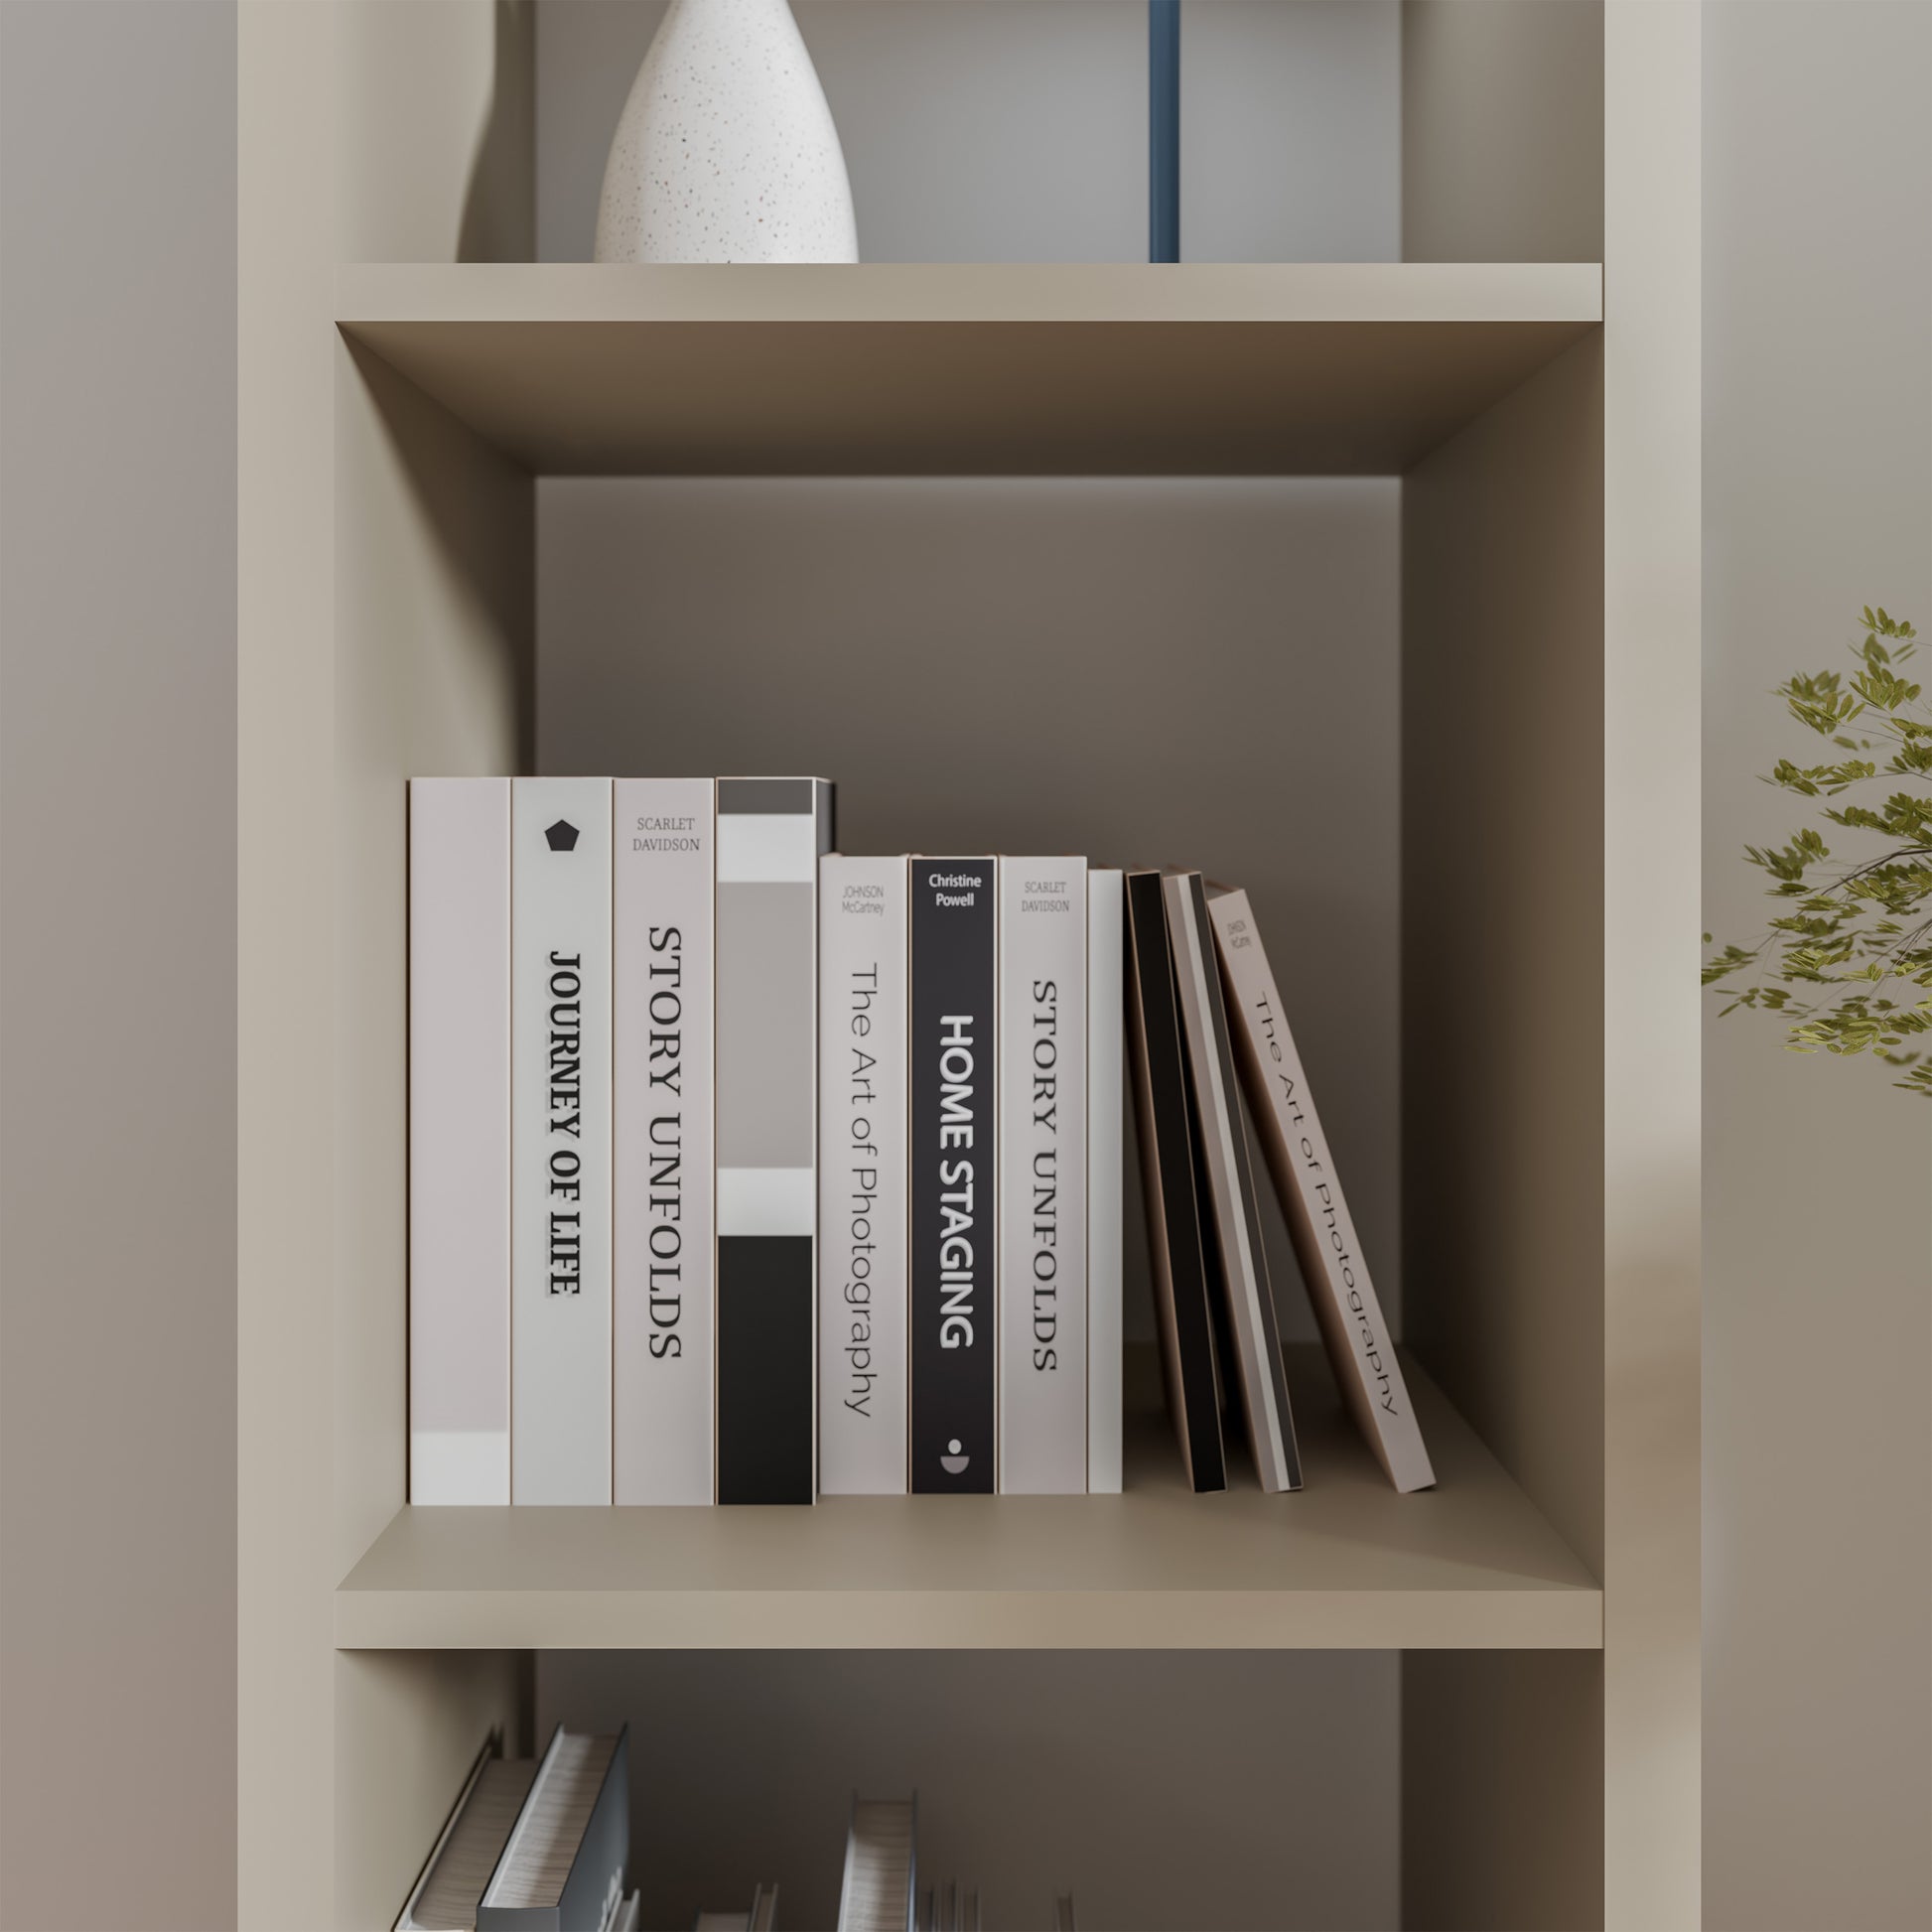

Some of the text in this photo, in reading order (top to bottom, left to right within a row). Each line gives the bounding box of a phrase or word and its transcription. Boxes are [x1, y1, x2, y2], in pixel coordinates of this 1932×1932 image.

[636, 817, 696, 831] SCARLET
[632, 838, 701, 852] DAVIDSON
[928, 874, 982, 888] Christine
[1025, 882, 1067, 894] SCARLET
[842, 886, 885, 898] JOHNSON
[935, 893, 975, 906] Powell
[842, 900, 885, 916] McCartney
[1021, 899, 1070, 912] DAVIDSON
[549, 950, 582, 1295] JOURNEY OF LIFE
[648, 926, 682, 1359] STORY UNFOLDS
[939, 1015, 974, 1349] HOME STAGING
[1033, 980, 1057, 1372] STORY UNFOLDS
[843, 962, 878, 1418] The Art of Photography
[1256, 992, 1398, 1417] The Art of Photography
